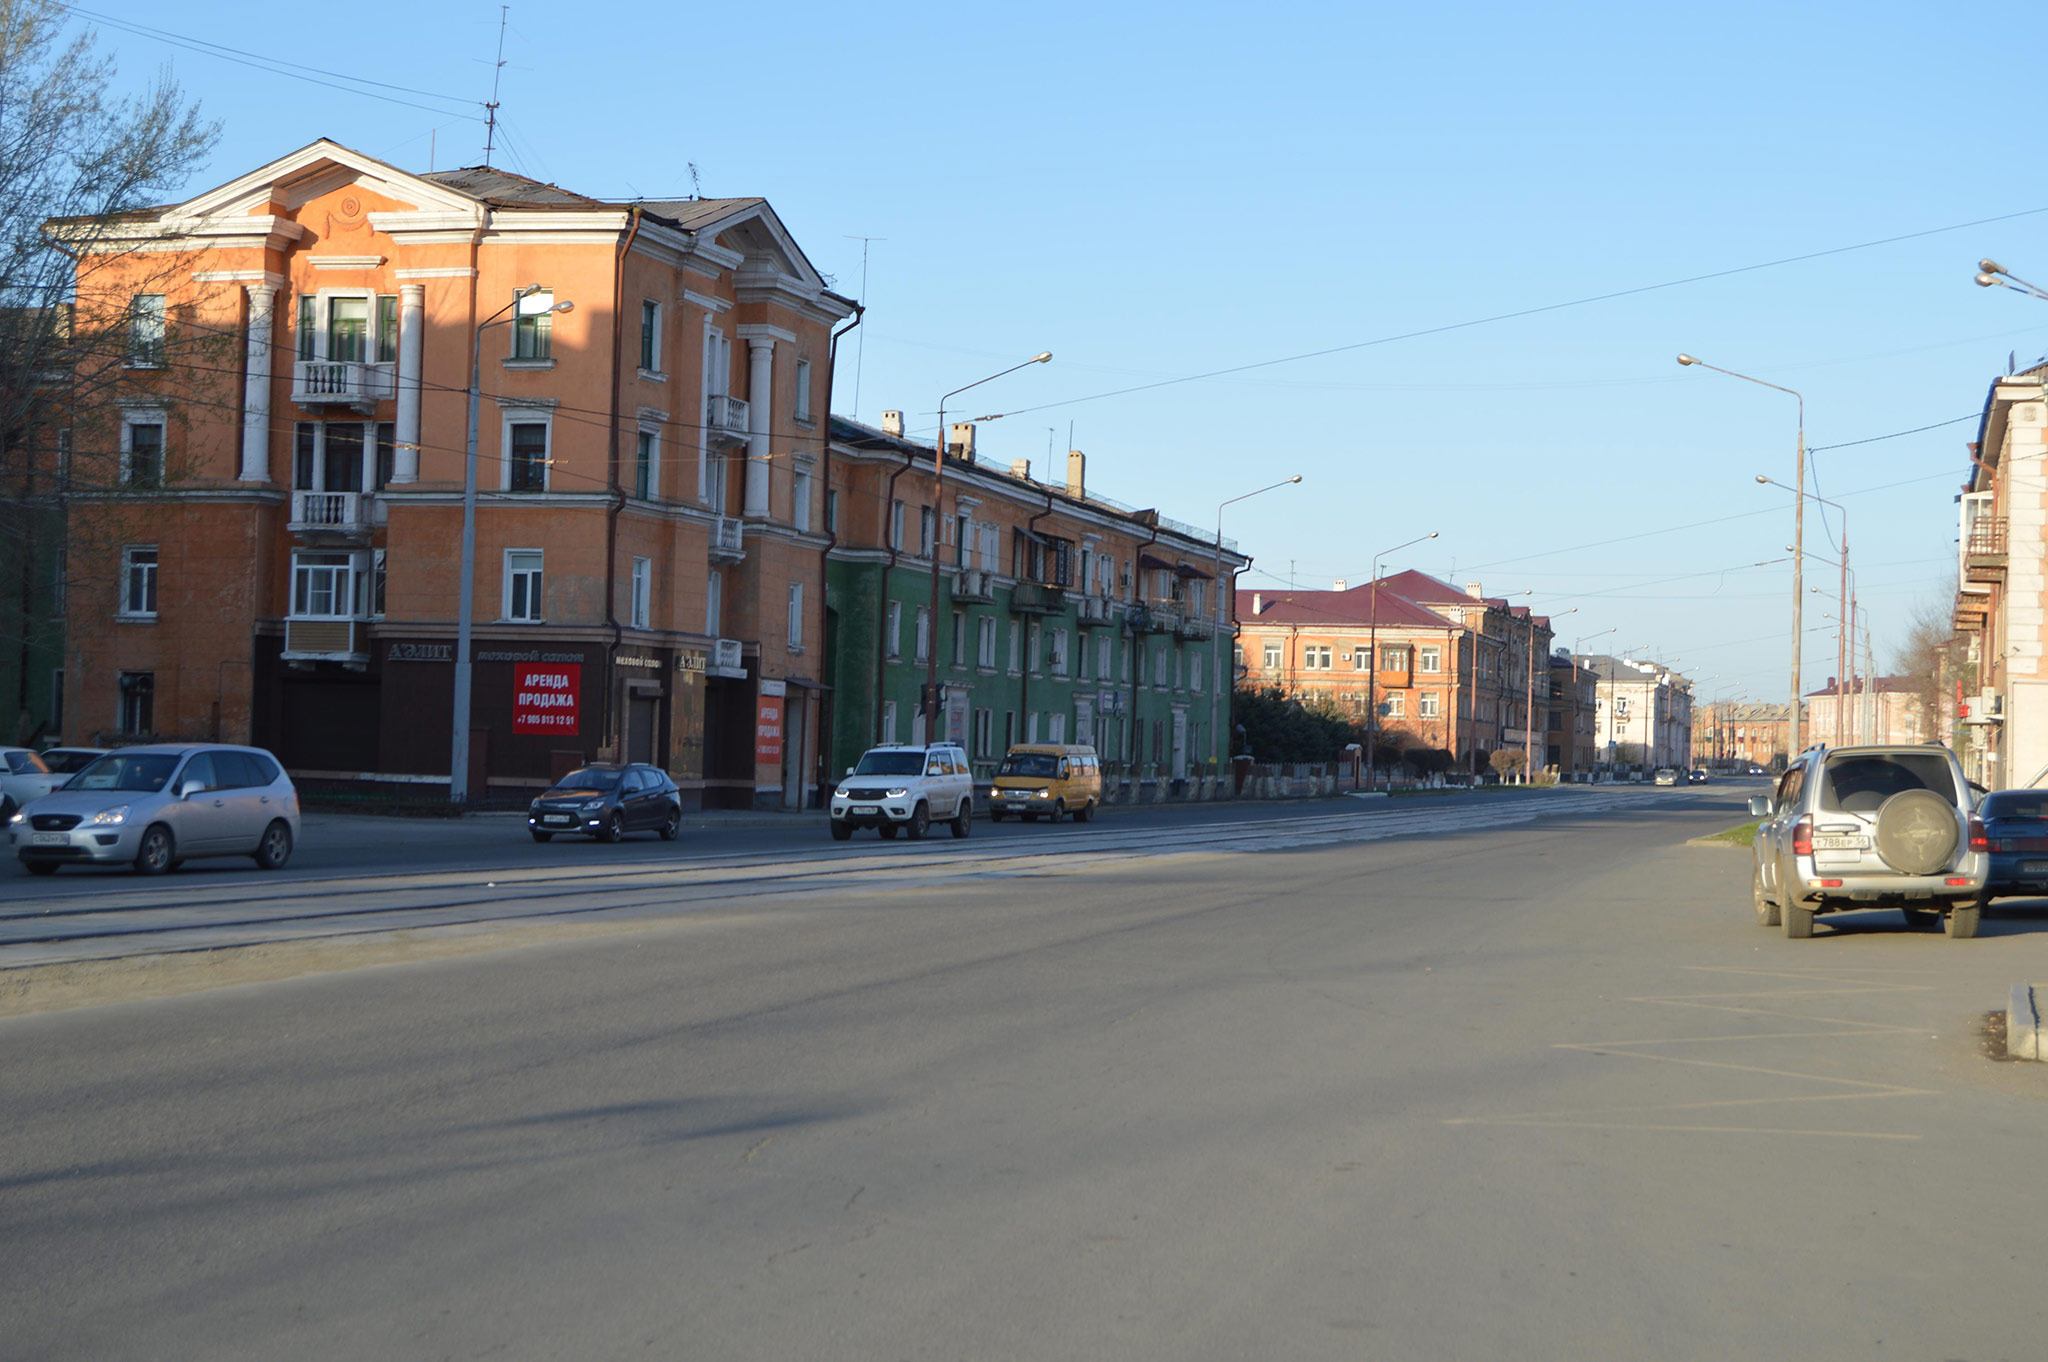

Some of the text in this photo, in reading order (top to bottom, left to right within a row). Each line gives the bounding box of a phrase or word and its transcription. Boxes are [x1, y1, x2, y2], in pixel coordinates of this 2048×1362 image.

[525, 674, 569, 688] АРЕНДА
[518, 692, 574, 708] ПРОДАЖА
[517, 715, 526, 724] +7
[541, 715, 555, 725] 813
[556, 716, 565, 725] 12
[566, 716, 575, 726] 51
